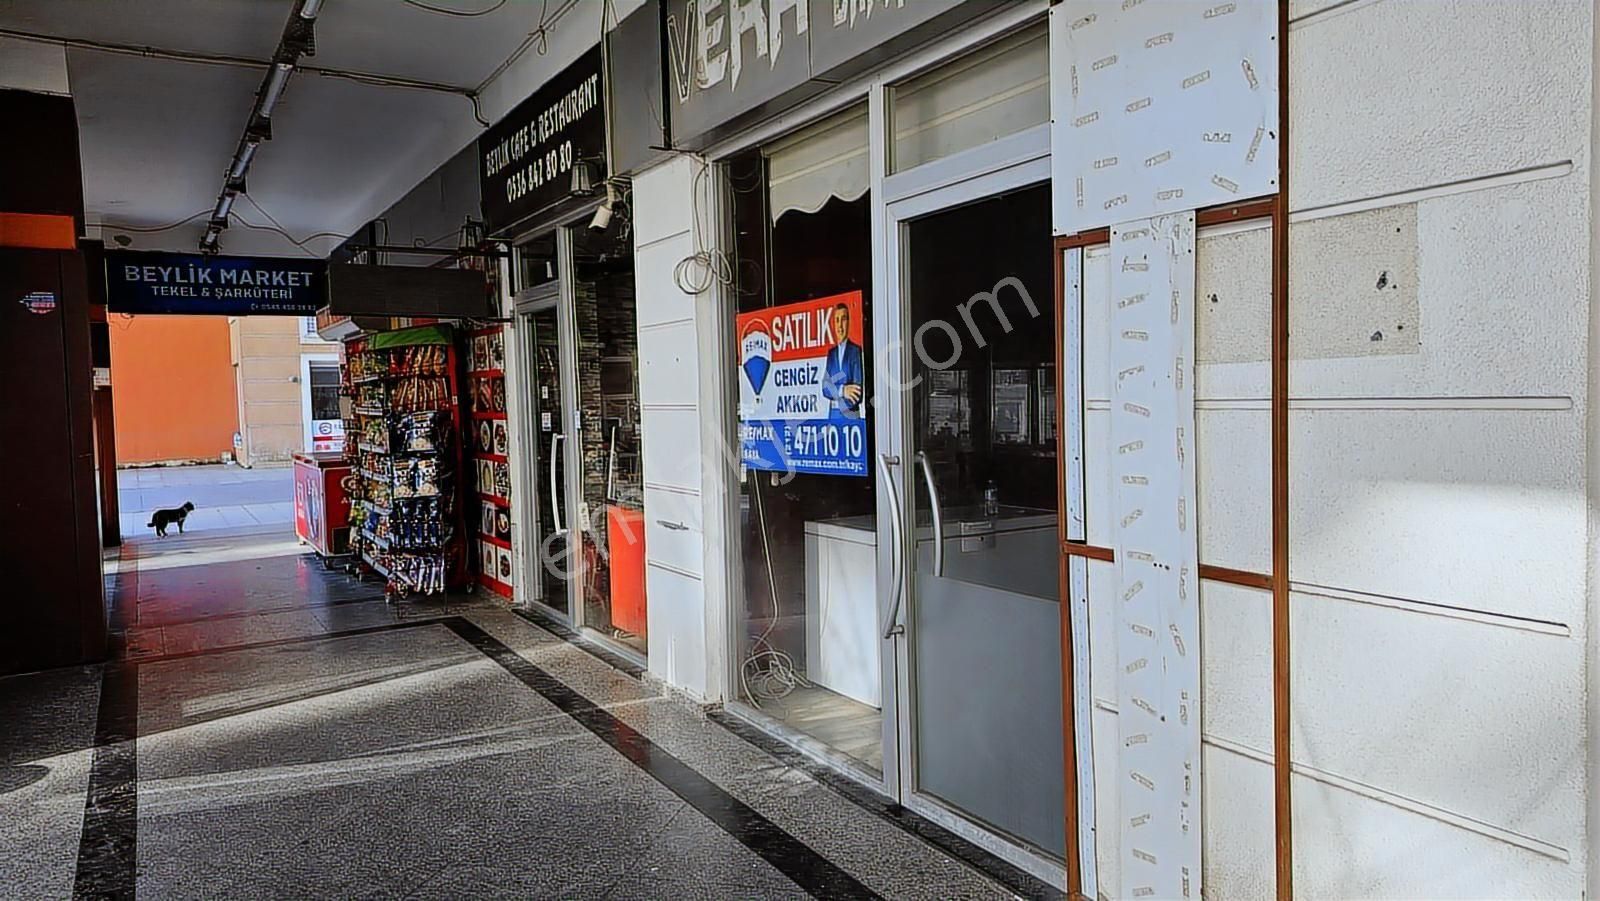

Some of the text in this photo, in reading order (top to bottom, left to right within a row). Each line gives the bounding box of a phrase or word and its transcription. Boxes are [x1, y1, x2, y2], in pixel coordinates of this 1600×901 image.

[510, 126, 529, 160] CAFE
[538, 73, 598, 143] RESTAURANT
[506, 140, 572, 203] 0536 842 80 80
[125, 263, 313, 287] BEYLİK MARKET
[152, 286, 293, 300] TEKEL & ŞARKÜTERİ
[772, 306, 836, 353] SATILIK
[774, 361, 819, 387] CENGİZ
[776, 394, 818, 413] AKKOR
[842, 425, 862, 458] 10
